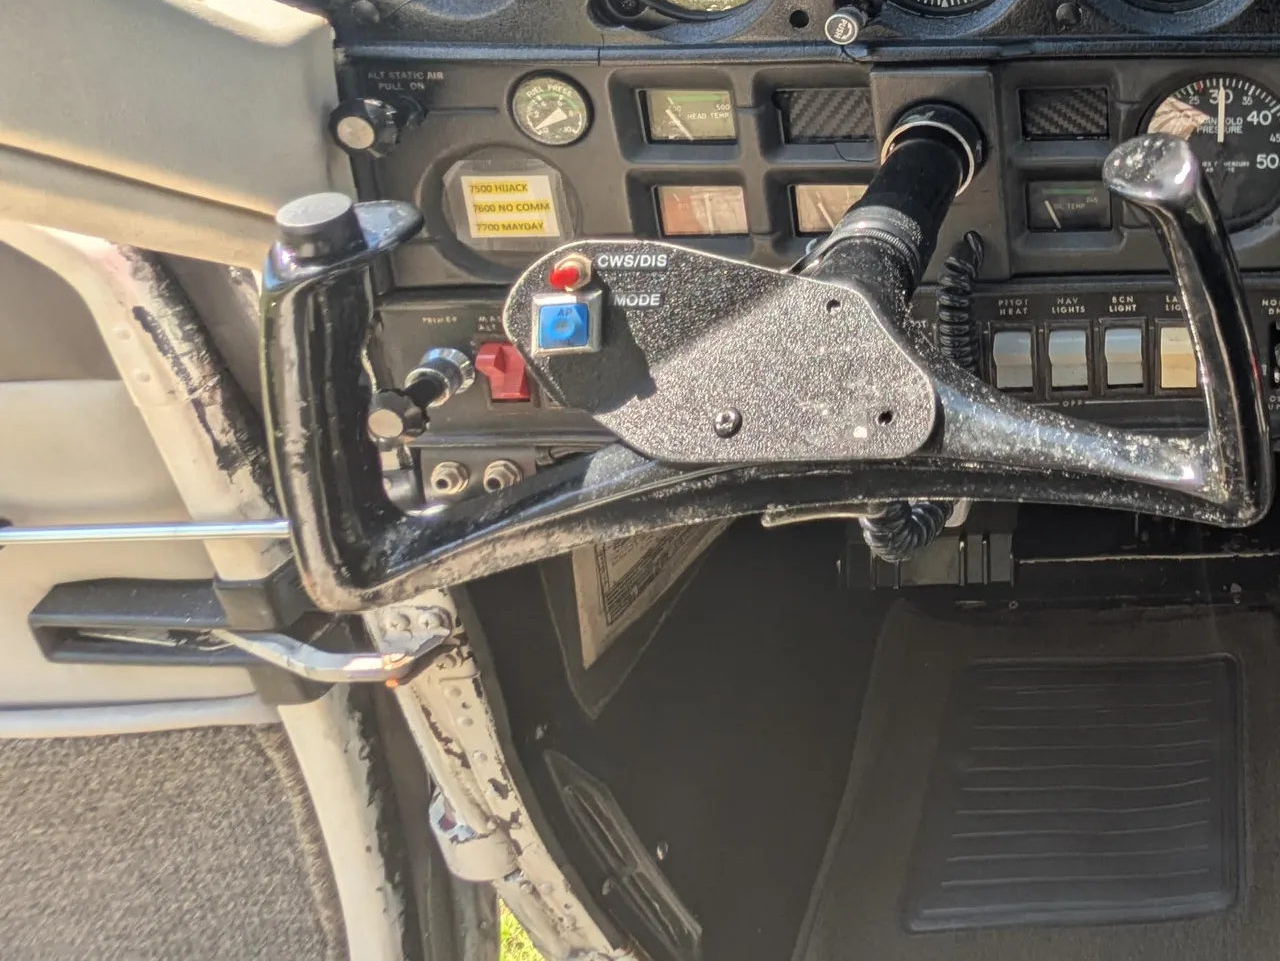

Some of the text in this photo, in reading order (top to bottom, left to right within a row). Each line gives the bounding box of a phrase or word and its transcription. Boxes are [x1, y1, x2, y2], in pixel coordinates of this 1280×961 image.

[427, 71, 444, 80] AIR
[1247, 110, 1272, 125] 40
[1269, 134, 1280, 143] 45
[1256, 154, 1279, 169] 50
[469, 184, 528, 194] 7500 HIJACK
[473, 203, 550, 213] 7600 NO COMM
[476, 222, 544, 232] 7700 MAYDAY
[598, 254, 667, 267] CWS/DIS
[614, 294, 660, 306] MODE
[1057, 297, 1078, 305] NAV
[1052, 305, 1086, 314] LIGHTS
[1109, 304, 1137, 312] LIGHT
